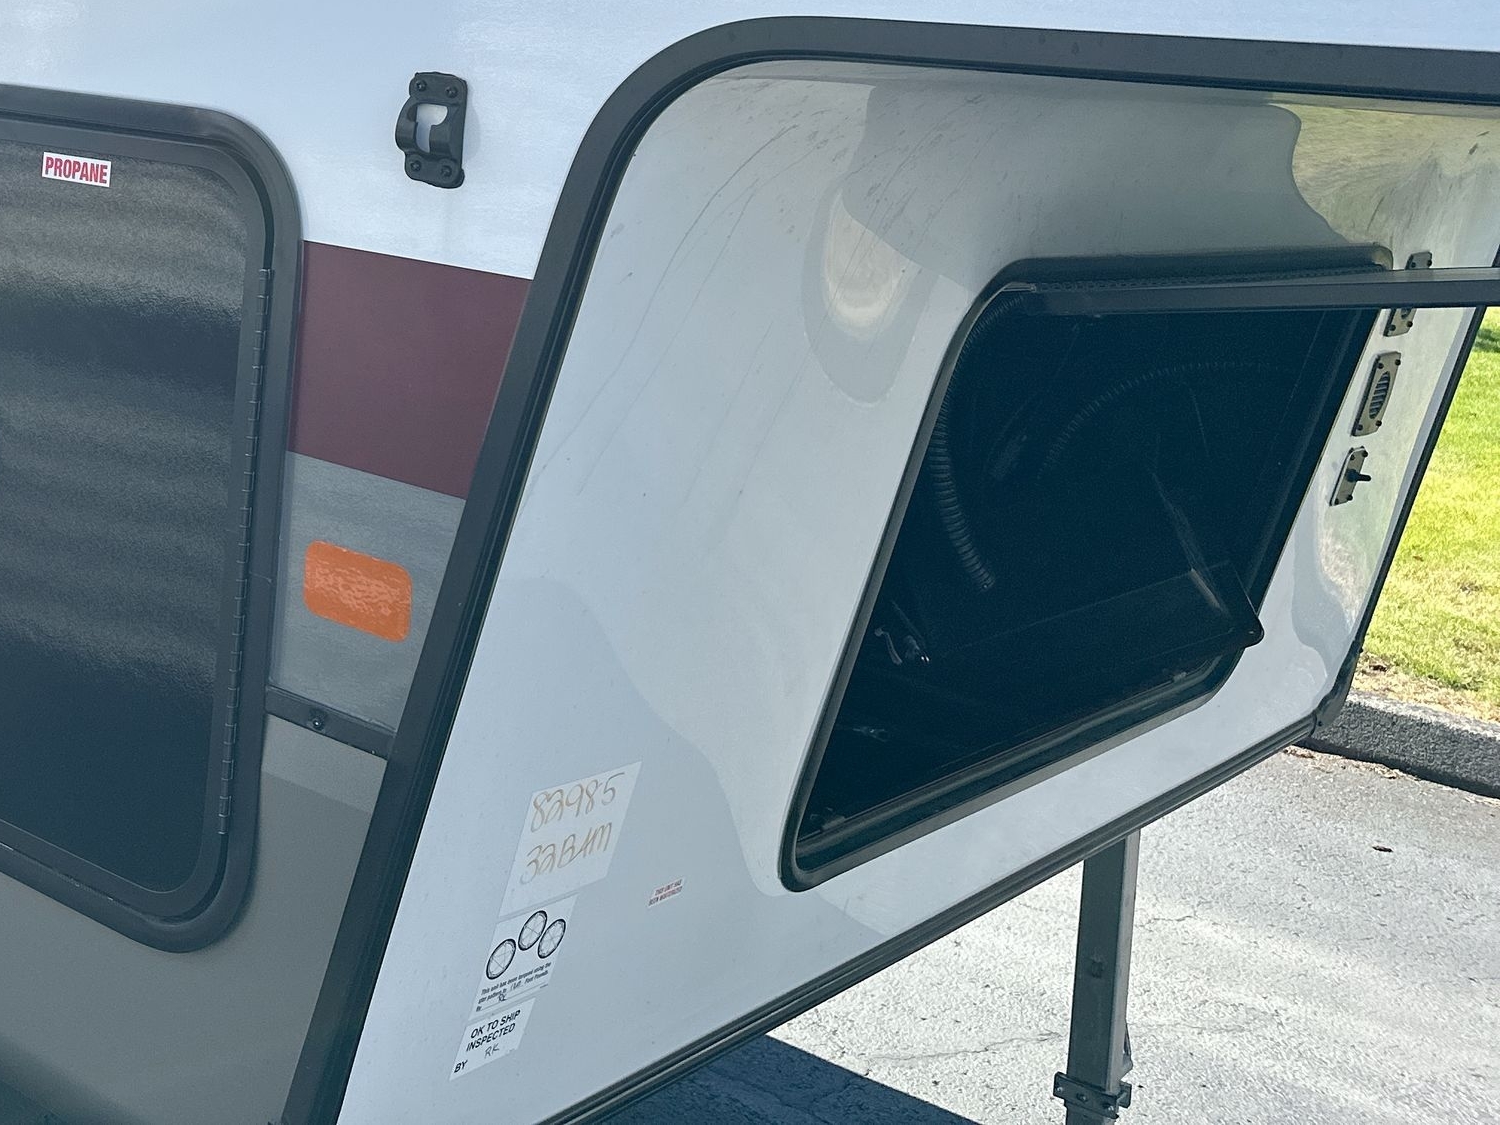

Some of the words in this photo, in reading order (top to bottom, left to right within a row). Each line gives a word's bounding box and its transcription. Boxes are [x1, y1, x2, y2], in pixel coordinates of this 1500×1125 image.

[44, 156, 108, 184] PROPANE
[466, 1022, 516, 1052] INSPECTED
[470, 1024, 486, 1039] OK
[487, 1019, 499, 1032] TO
[499, 1009, 521, 1026] SHIP
[453, 1059, 468, 1073] BY
